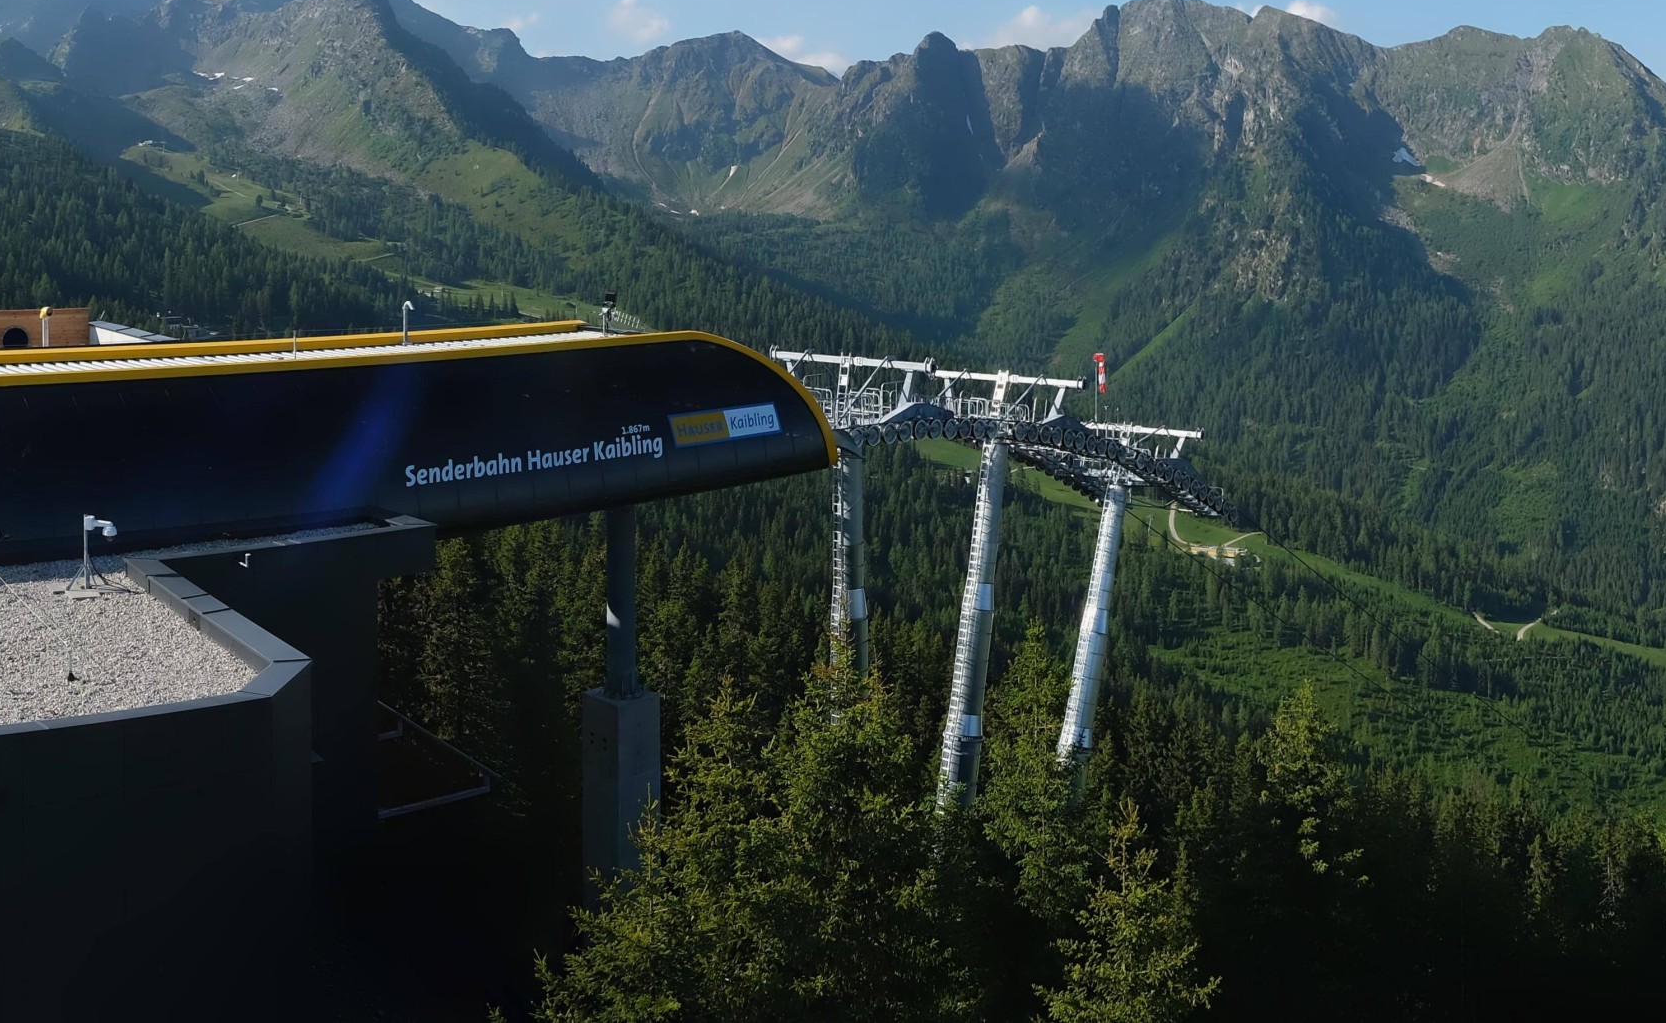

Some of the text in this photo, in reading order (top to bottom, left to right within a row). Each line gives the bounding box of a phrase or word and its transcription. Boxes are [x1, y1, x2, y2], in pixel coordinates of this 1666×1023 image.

[621, 423, 650, 436] 1.867m
[676, 411, 776, 438] HAUSER Kaibling
[405, 434, 663, 487] Senderbahn Hauser Kaibling
